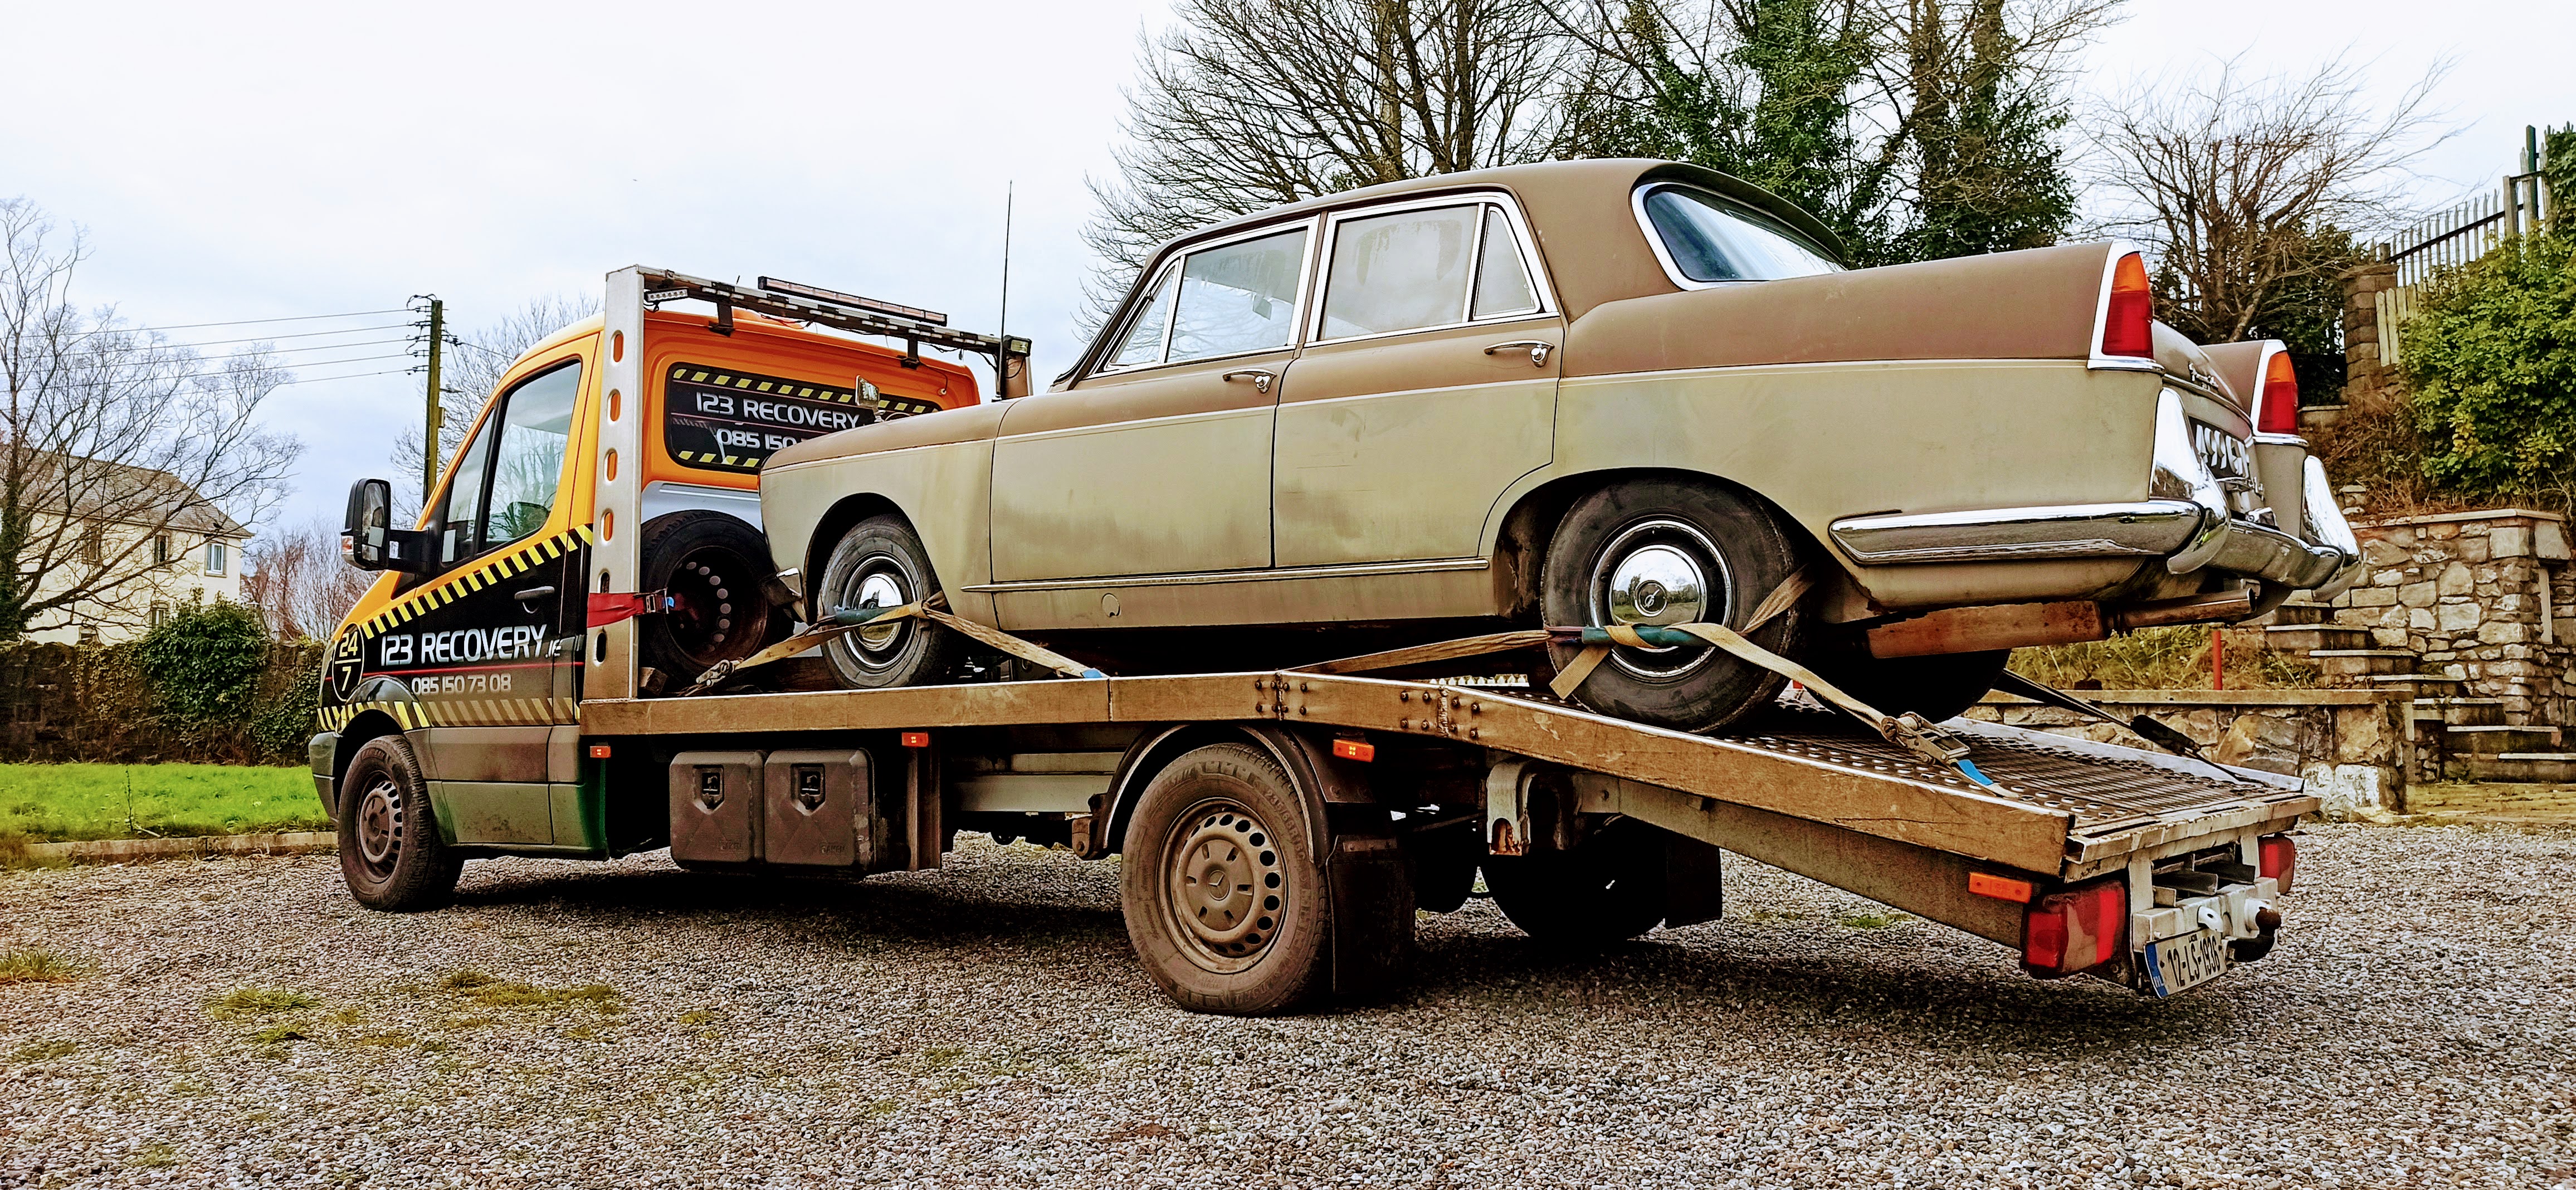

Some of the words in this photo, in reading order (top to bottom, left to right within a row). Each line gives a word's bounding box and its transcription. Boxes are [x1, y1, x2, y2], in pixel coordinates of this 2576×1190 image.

[696, 392, 734, 415] 123
[743, 398, 860, 430] RECOVERY
[716, 428, 760, 449] 085
[339, 631, 358, 657] 24
[381, 634, 413, 666] 123
[341, 666, 352, 691] 7
[411, 676, 440, 696] 085
[442, 675, 465, 695] 150
[467, 674, 486, 694] 73
[489, 672, 511, 694] 08
[2167, 935, 2221, 987] 12-LS-1936
